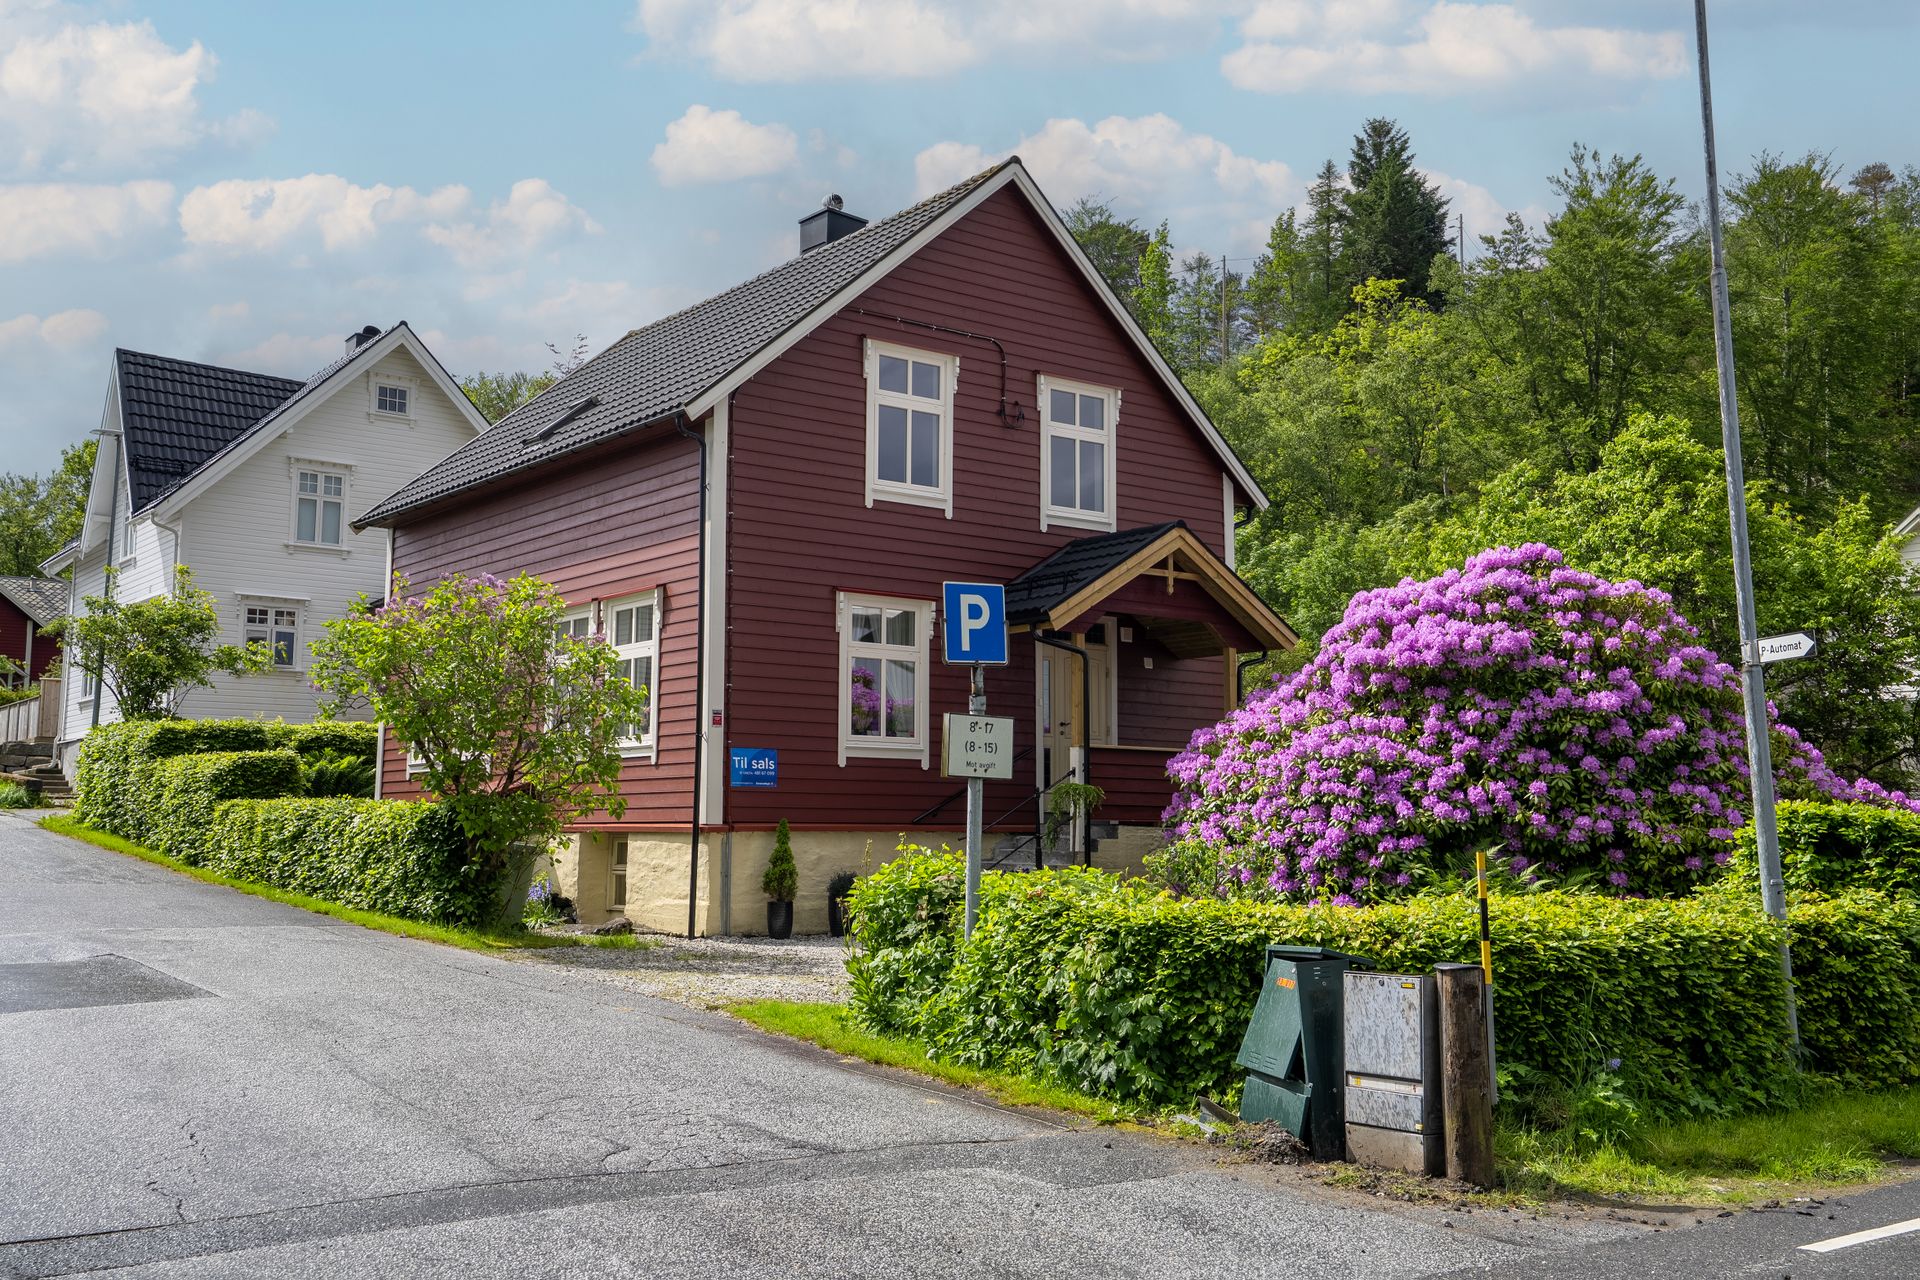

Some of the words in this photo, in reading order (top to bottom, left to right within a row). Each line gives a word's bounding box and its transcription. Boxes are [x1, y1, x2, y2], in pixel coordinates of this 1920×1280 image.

[960, 593, 990, 651] P
[1761, 641, 1802, 655] P-Automat
[732, 756, 748, 769] Til
[751, 757, 775, 770] sals
[979, 762, 996, 770] avgift
